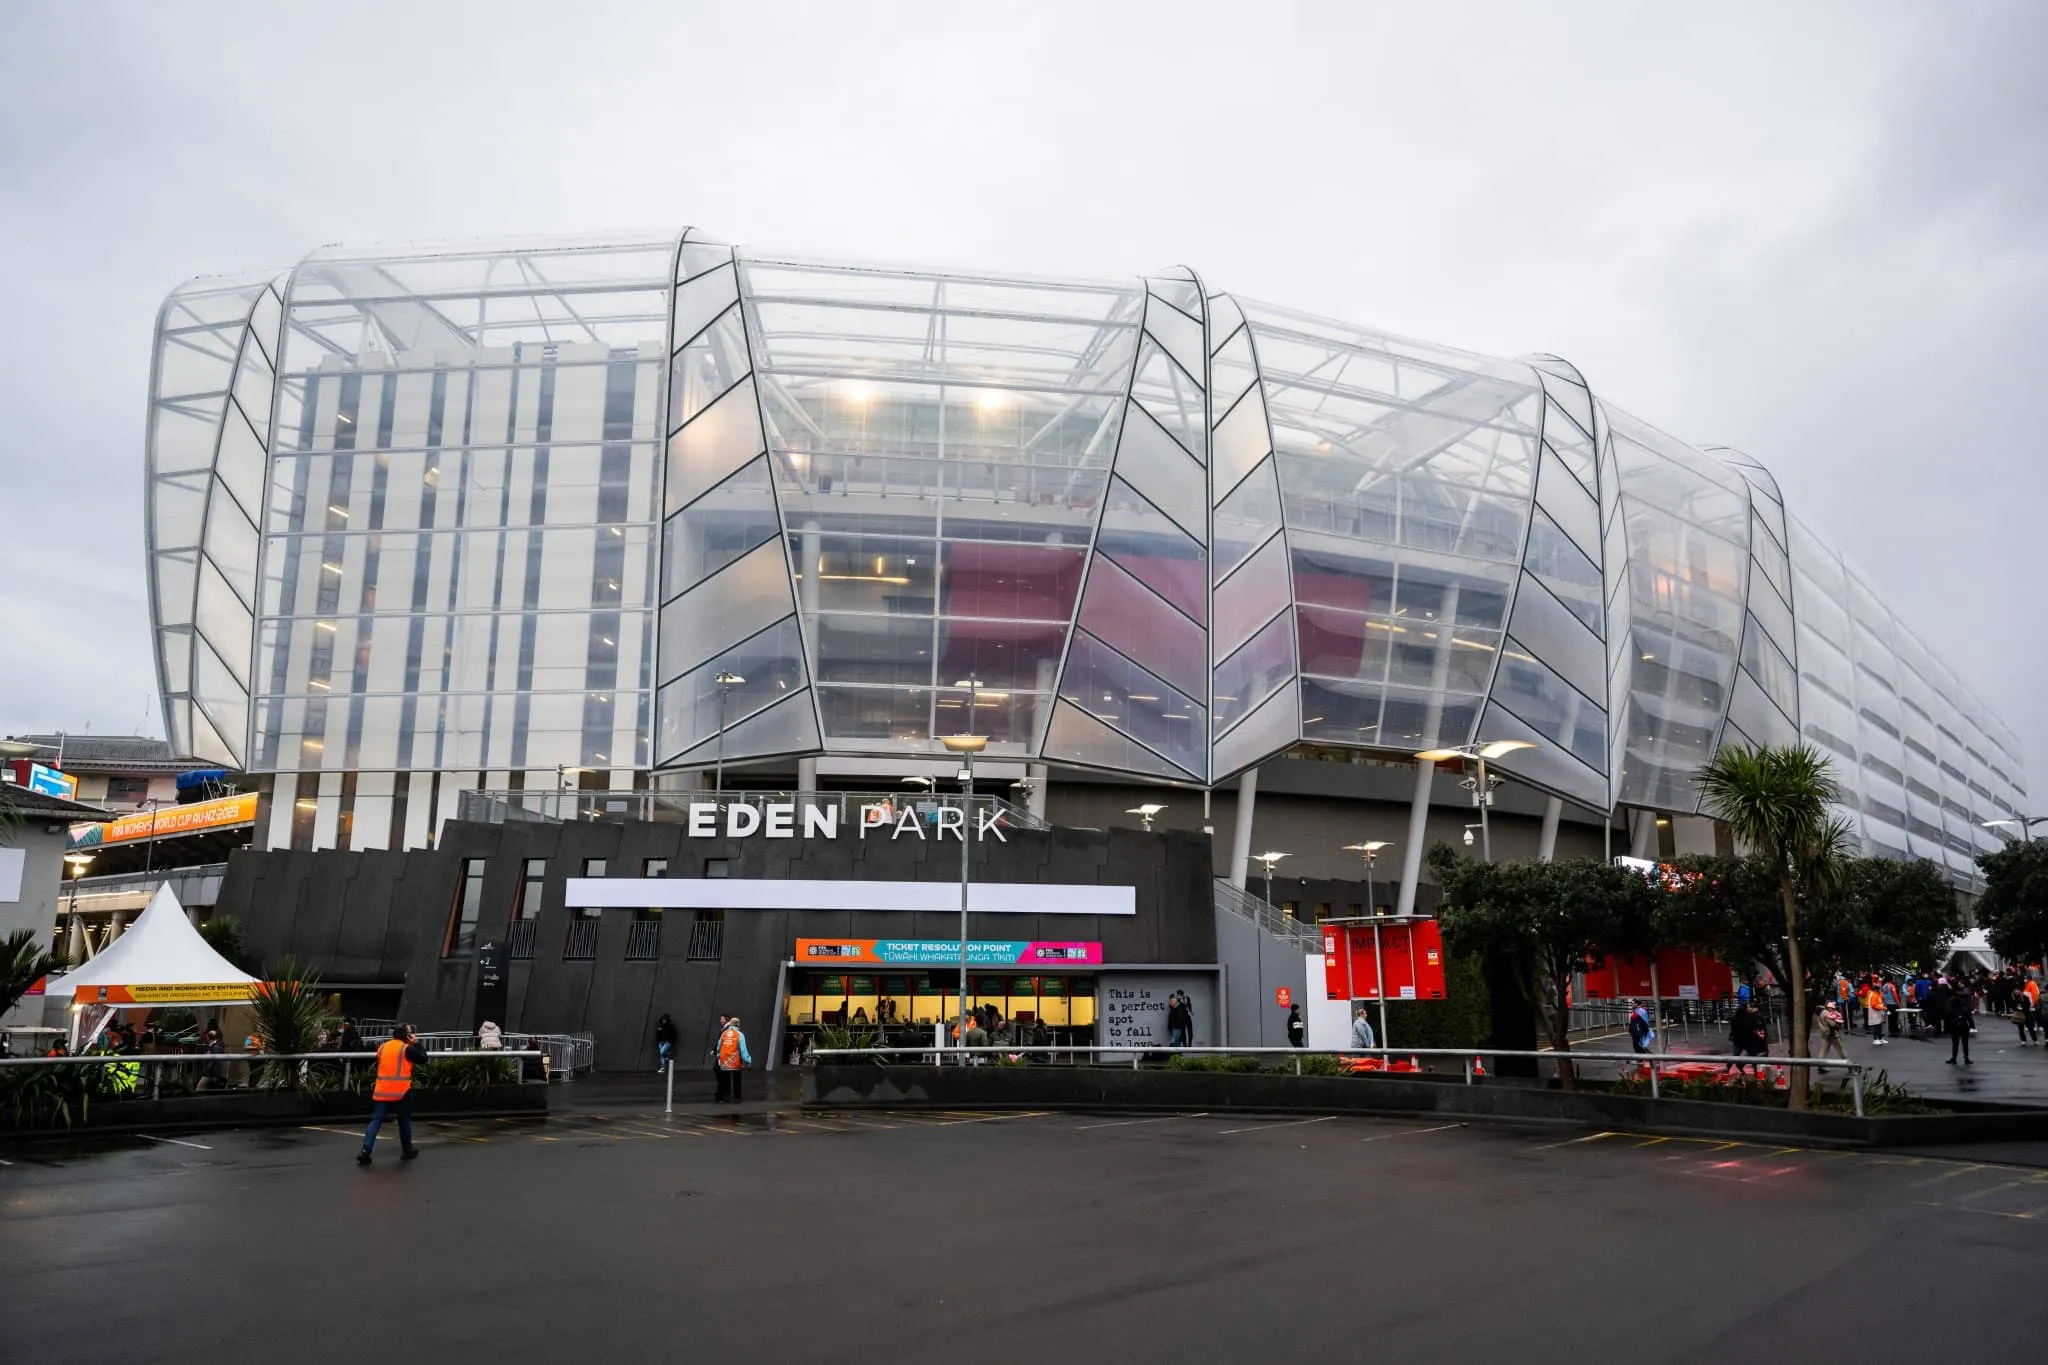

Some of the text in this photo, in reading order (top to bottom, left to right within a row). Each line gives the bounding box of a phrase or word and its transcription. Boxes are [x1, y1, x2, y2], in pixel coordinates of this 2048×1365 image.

[178, 813, 191, 827] CUP
[688, 803, 1008, 843] EDEN PARK
[886, 943, 920, 951] TICKET
[983, 944, 1012, 952] POINT
[1108, 989, 1151, 999] This is
[1108, 1002, 1166, 1013] a perfect
[1108, 1015, 1134, 1026] spot
[1109, 1027, 1153, 1037] to fall
